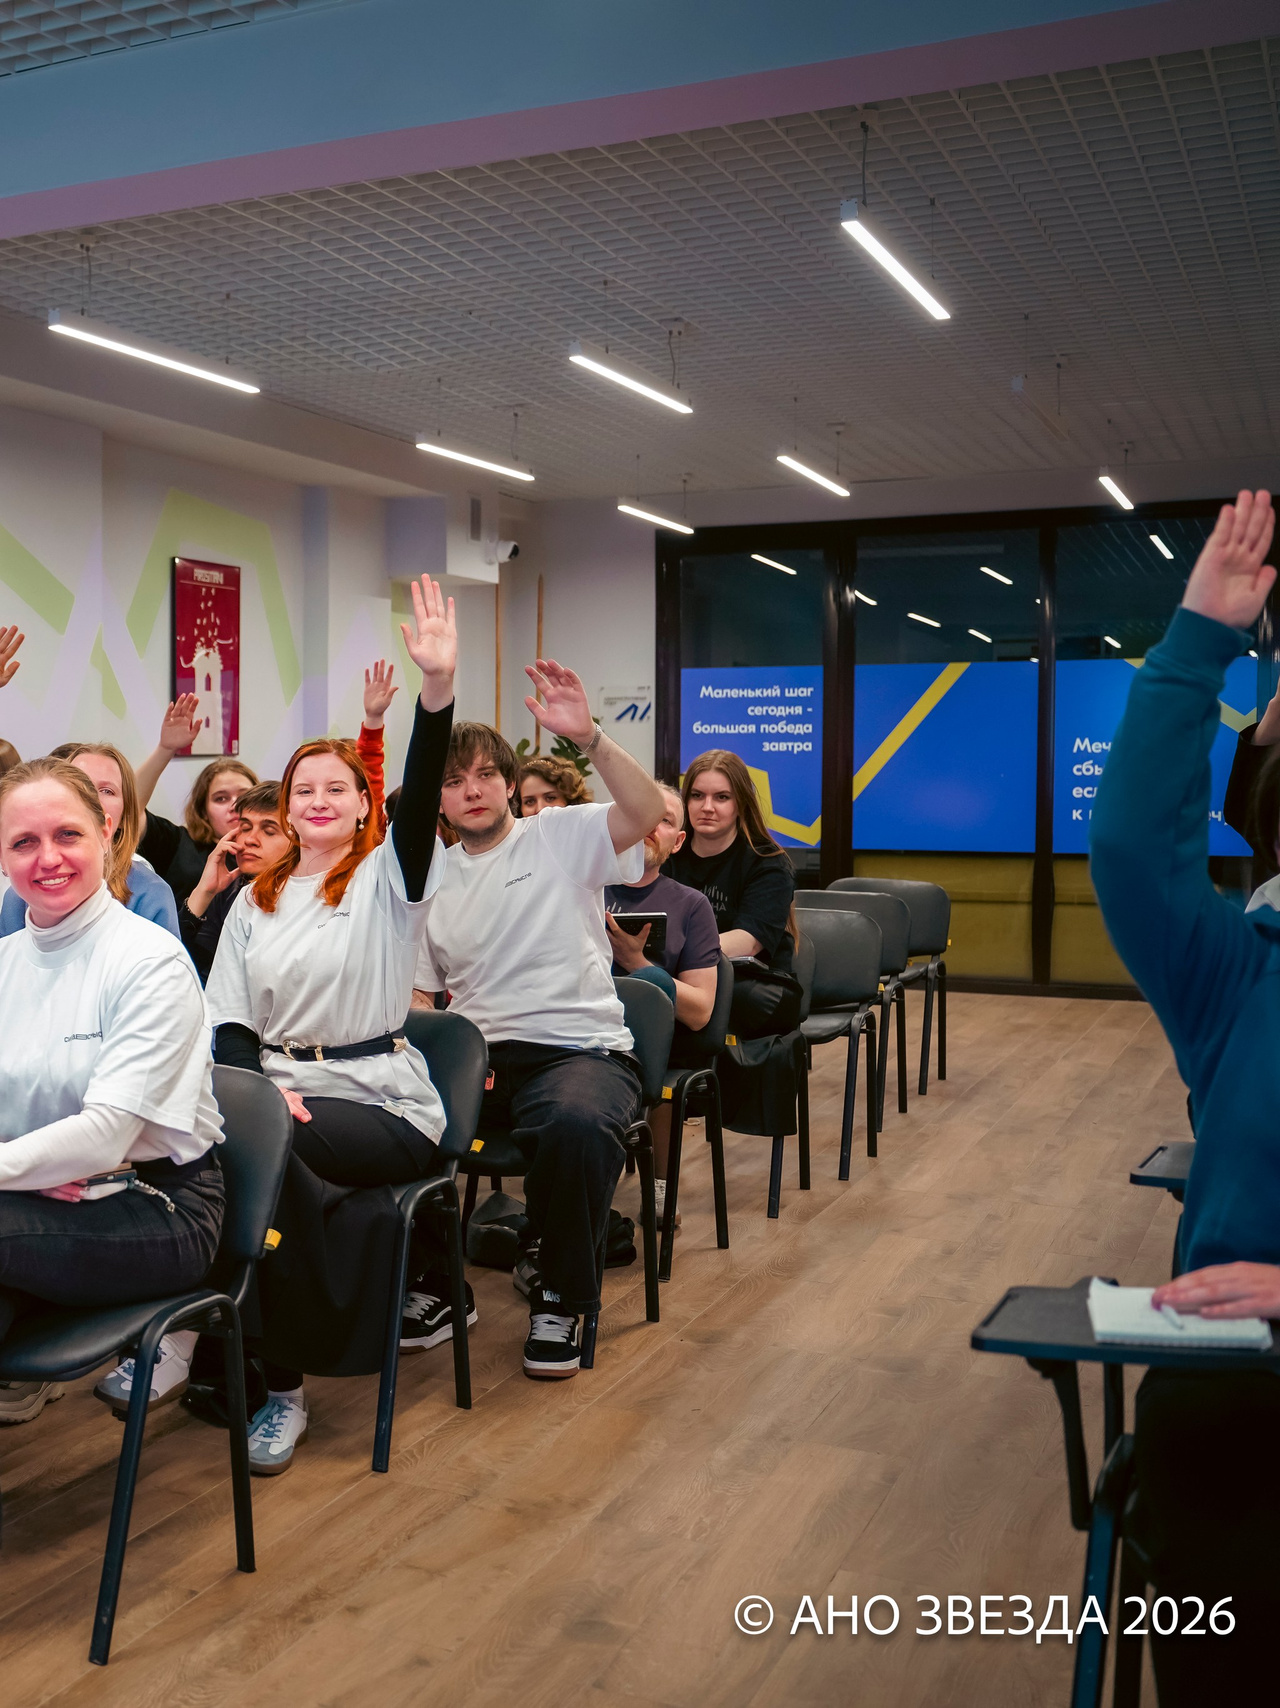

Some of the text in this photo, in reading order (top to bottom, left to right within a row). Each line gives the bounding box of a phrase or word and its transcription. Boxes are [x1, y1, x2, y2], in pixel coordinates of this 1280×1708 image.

[699, 685, 814, 698] Маленький шаг
[747, 705, 802, 717] сегодня
[692, 720, 813, 735] большая победа
[762, 741, 812, 754] завтра
[542, 1289, 561, 1304] VANS
